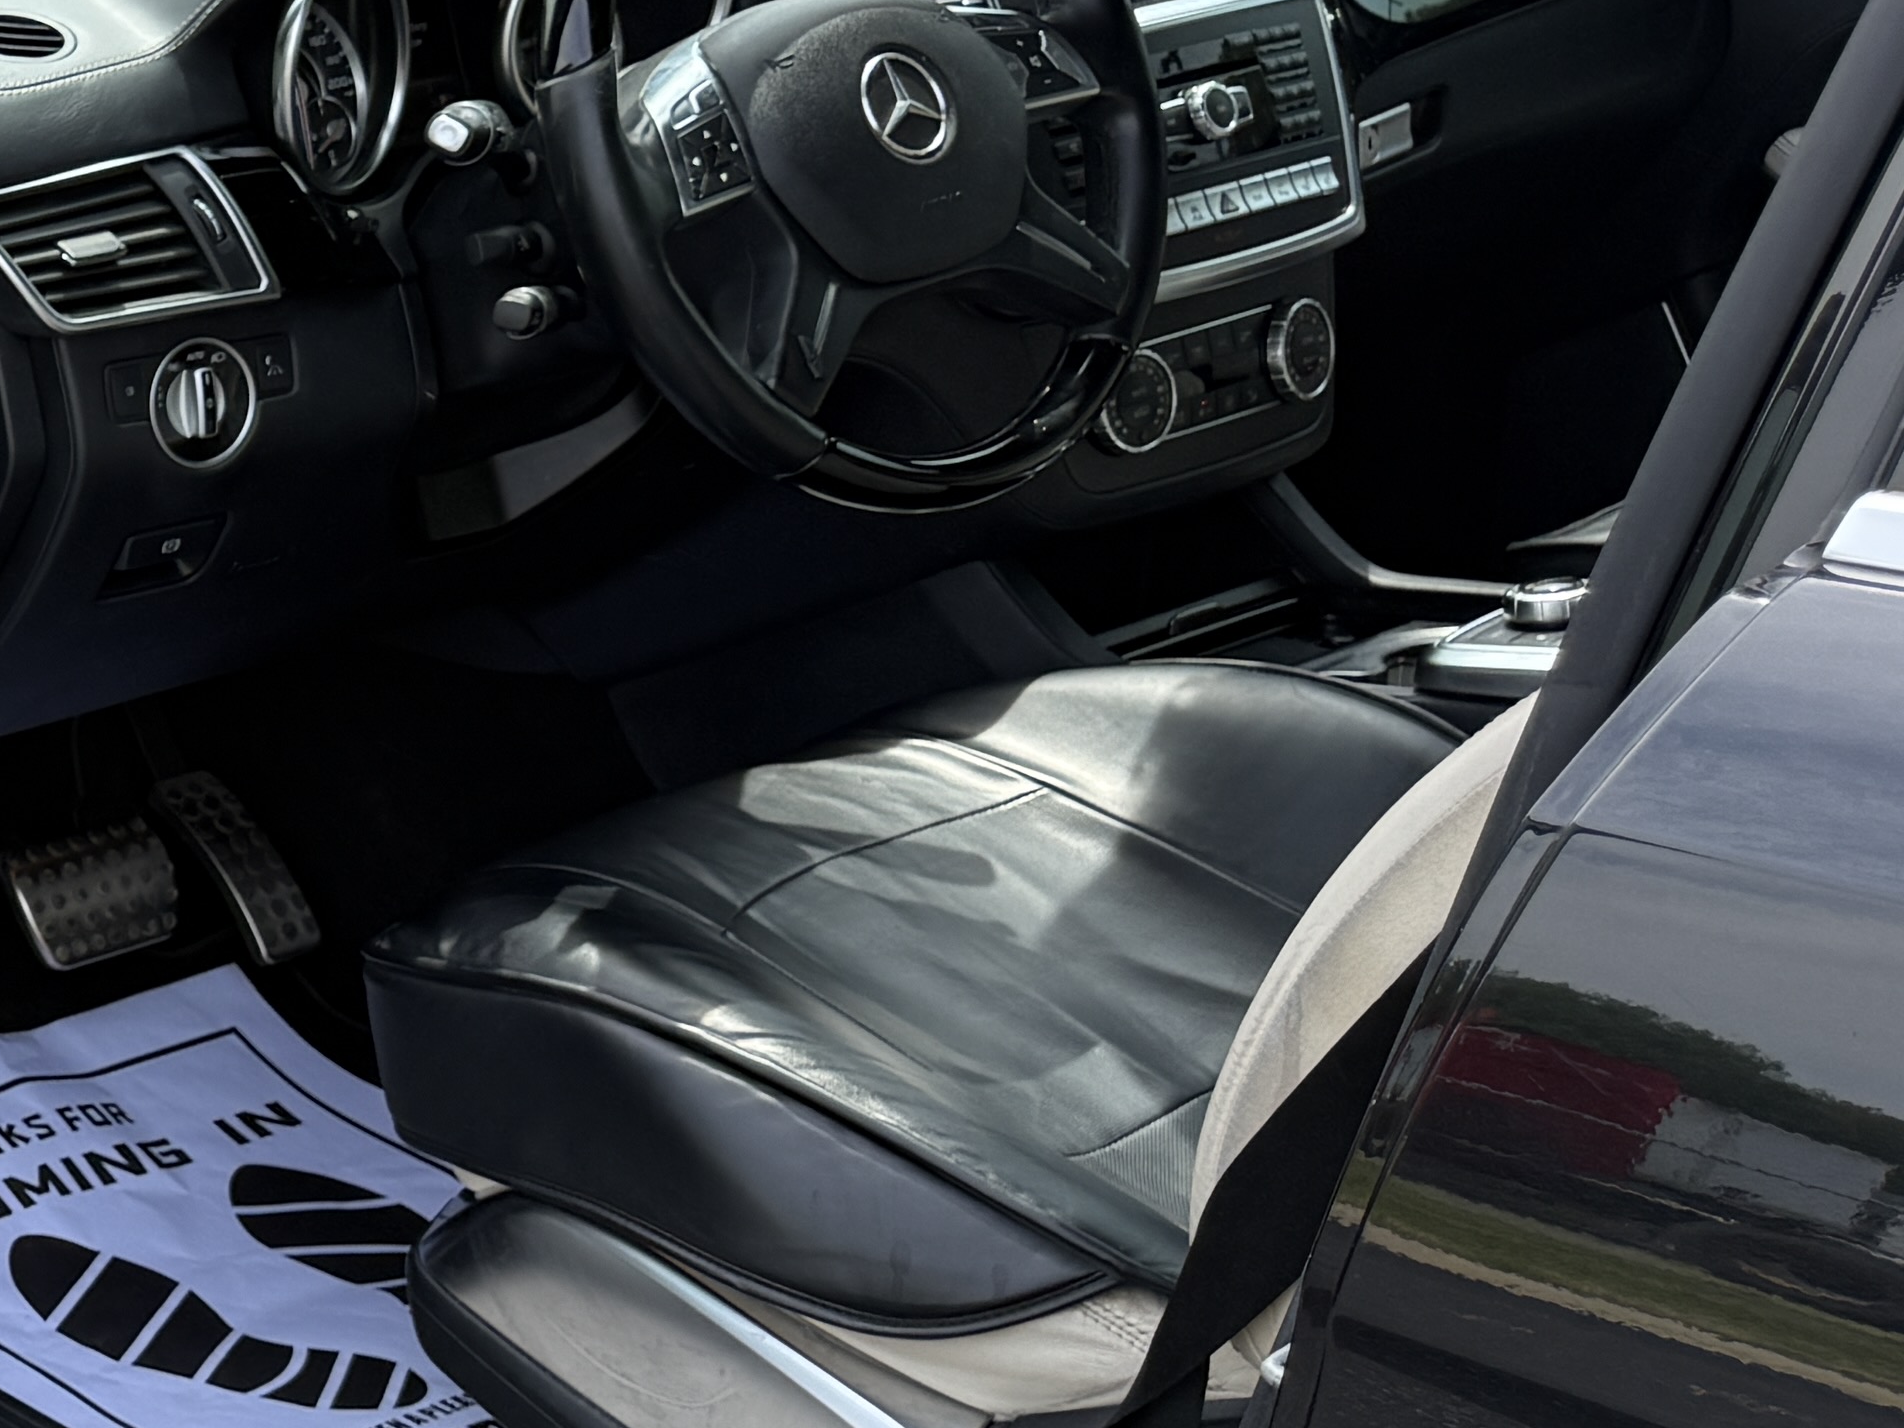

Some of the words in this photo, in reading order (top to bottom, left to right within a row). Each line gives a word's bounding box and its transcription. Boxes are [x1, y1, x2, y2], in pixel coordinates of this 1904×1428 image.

[55, 1101, 135, 1132] FOR
[213, 1101, 303, 1146] IN
[409, 1407, 429, 1425] A
